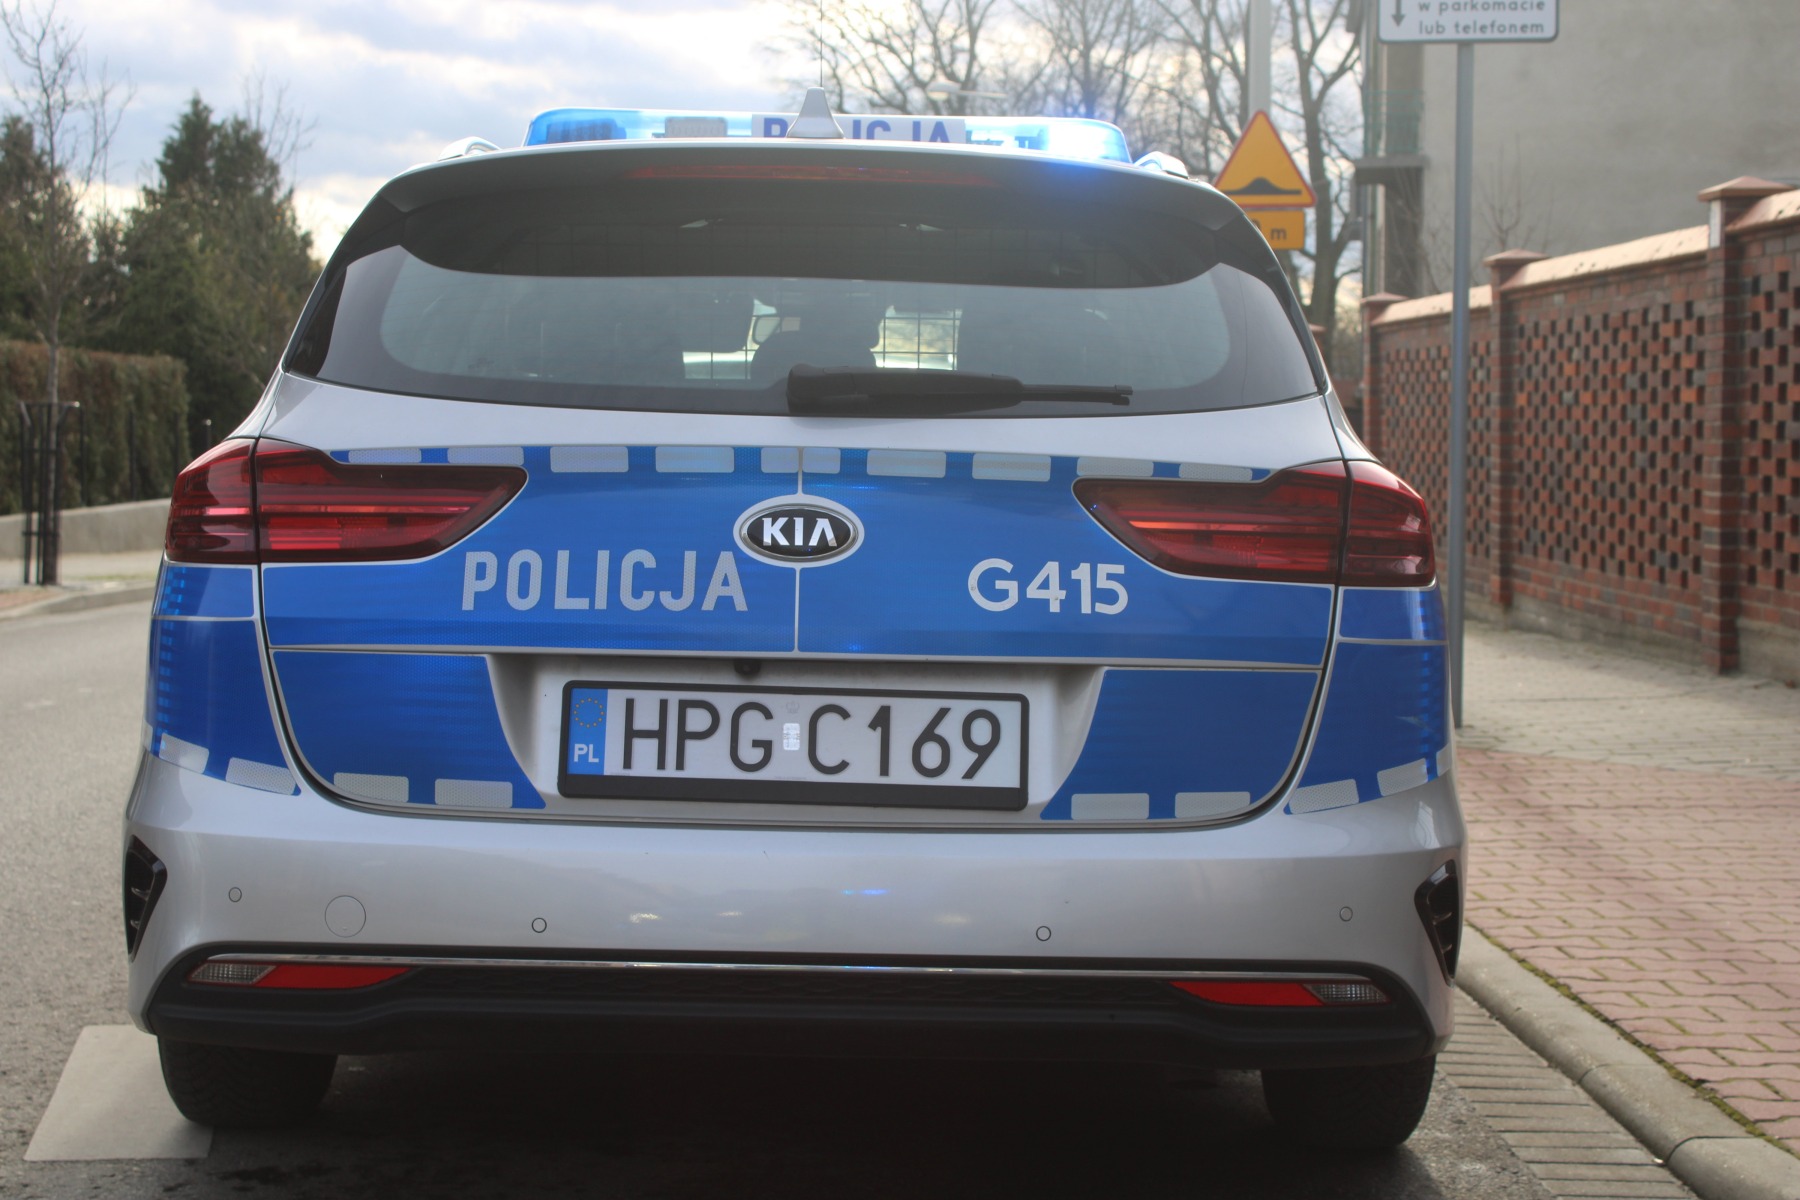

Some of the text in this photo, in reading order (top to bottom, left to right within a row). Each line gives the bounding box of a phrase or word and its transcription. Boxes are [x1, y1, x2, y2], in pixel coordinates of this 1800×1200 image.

[1418, 0, 1545, 16] w parkomacie
[1419, 20, 1544, 34] lub telefonem
[762, 516, 837, 547] KIA
[462, 548, 749, 612] POLICJA
[967, 557, 1129, 616] G415
[573, 697, 1001, 780] PL HPG C169
